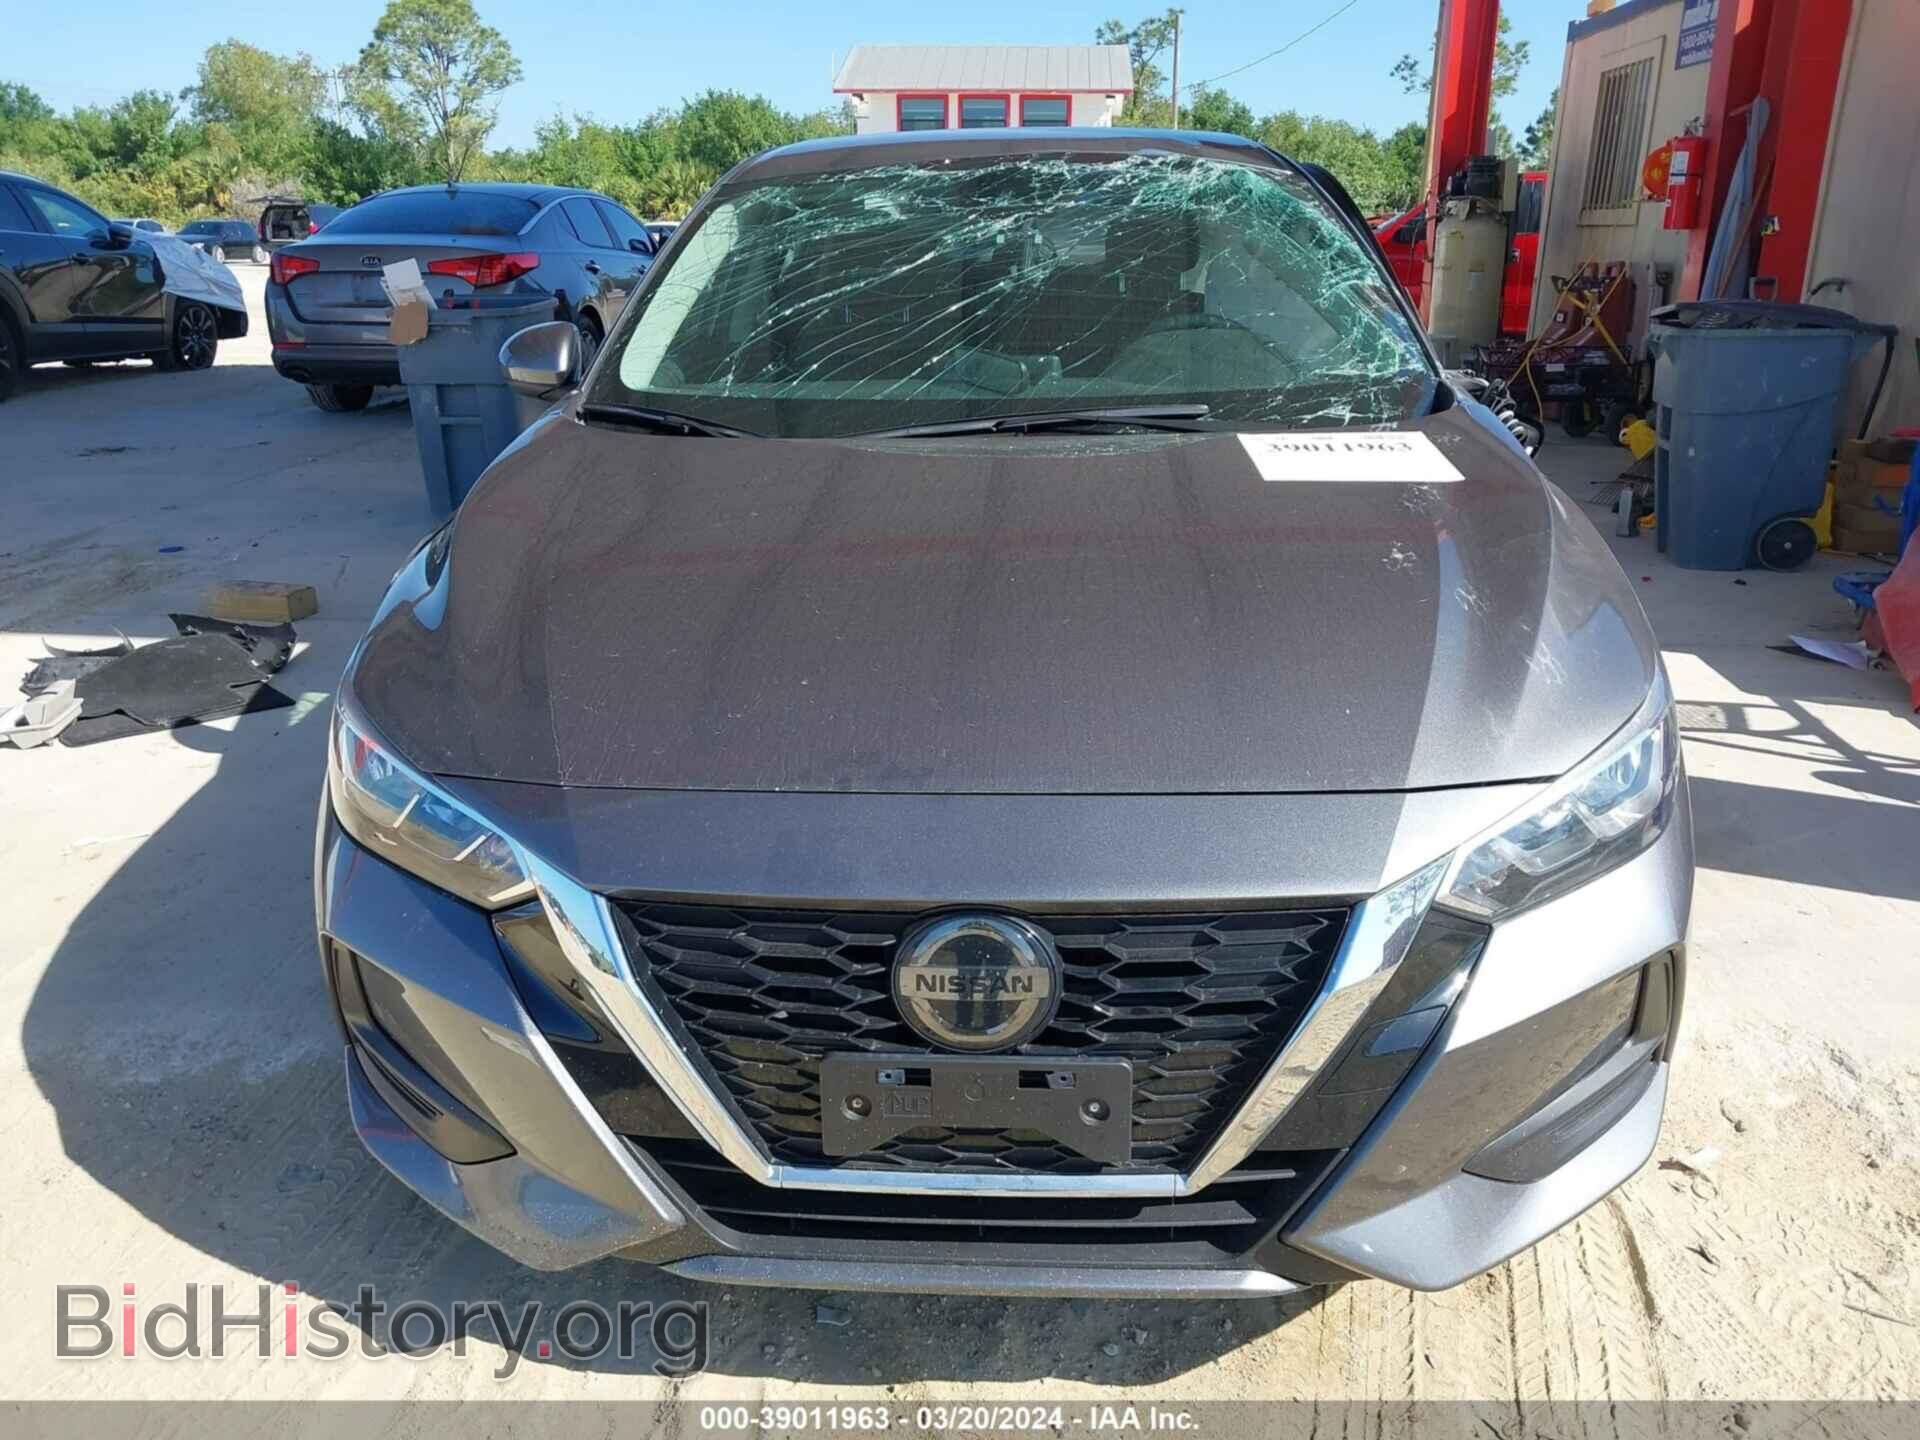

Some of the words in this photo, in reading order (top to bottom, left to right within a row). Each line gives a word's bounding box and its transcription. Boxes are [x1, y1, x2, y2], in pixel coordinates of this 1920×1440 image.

[363, 256, 380, 265] KIA
[1267, 441, 1413, 453] 39011963
[915, 974, 1033, 993] NISSAN
